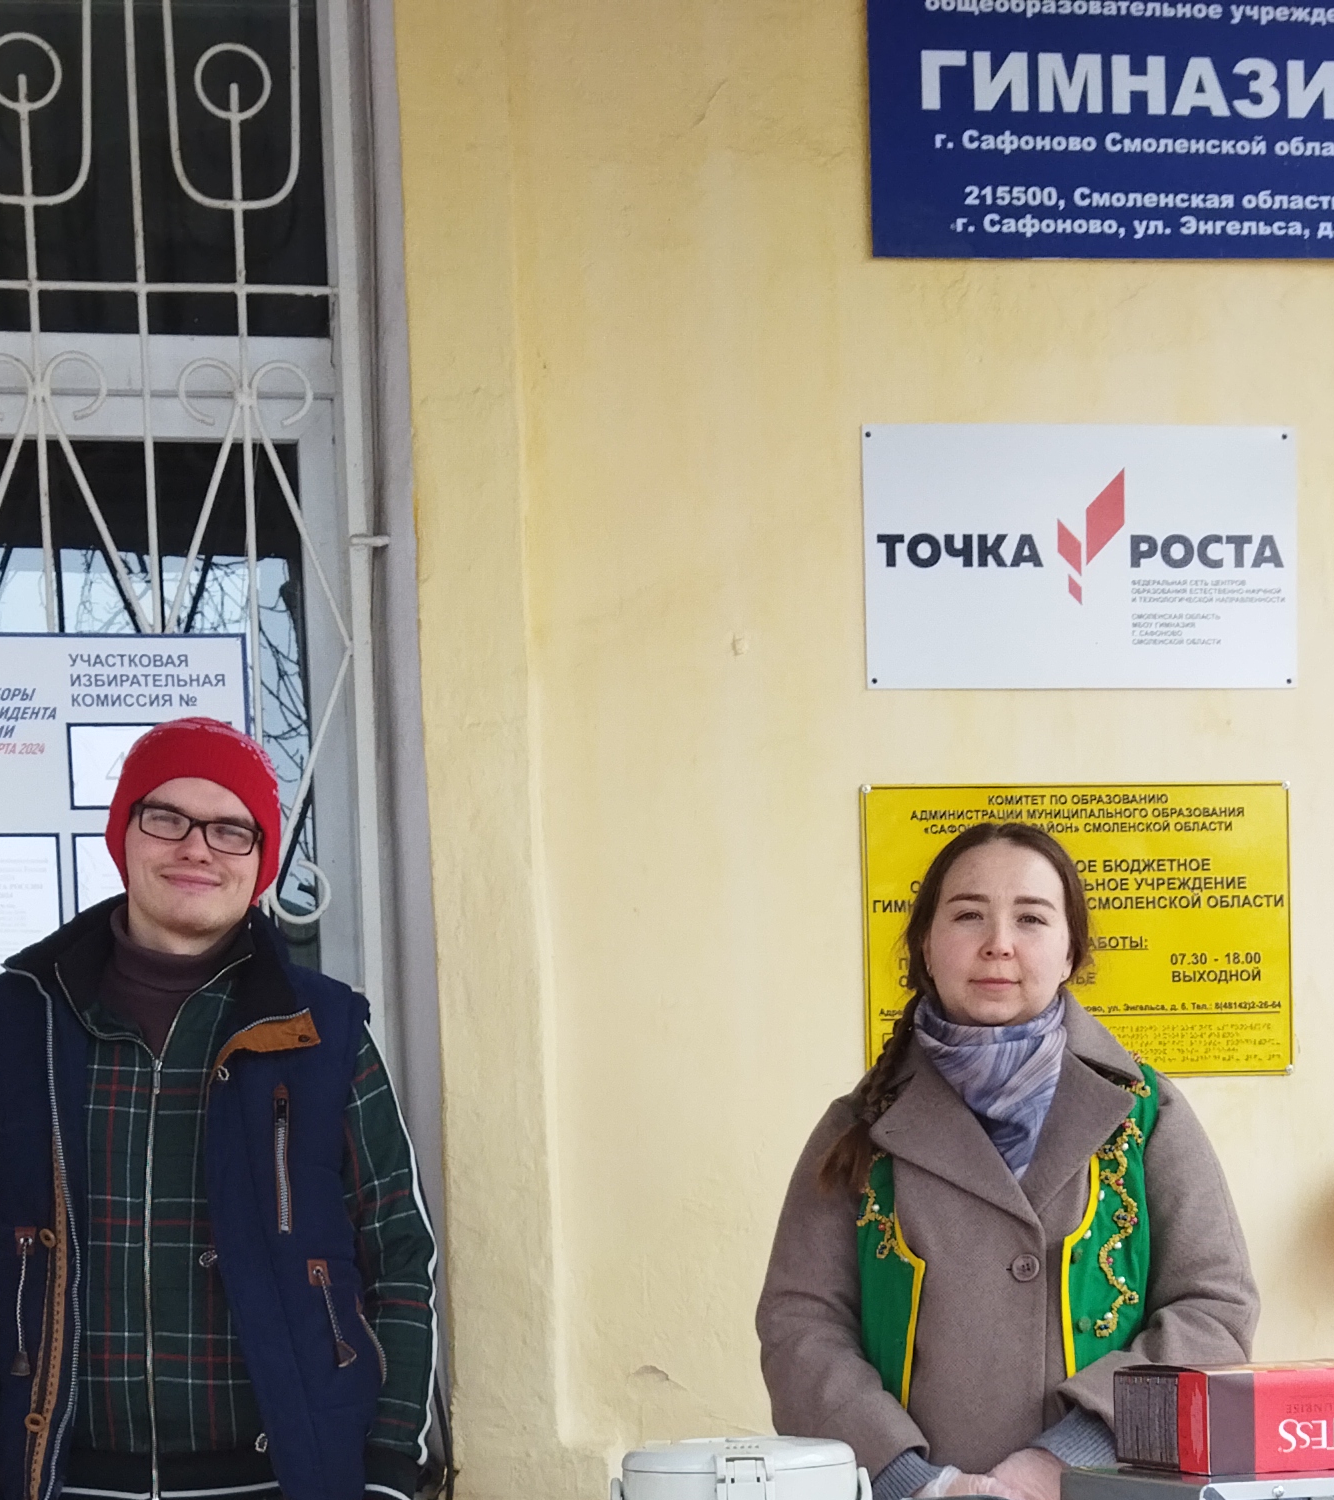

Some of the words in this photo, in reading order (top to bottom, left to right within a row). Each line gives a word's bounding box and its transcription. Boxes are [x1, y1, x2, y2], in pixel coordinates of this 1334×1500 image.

[935, 133, 953, 150] г.
[962, 130, 1097, 154] Сафоново
[1105, 132, 1267, 156] Смоленской
[964, 186, 1065, 210] 215500,
[1073, 186, 1235, 210] Смоленская
[955, 217, 975, 232] г.
[983, 214, 1125, 238] Сафоново,
[1133, 218, 1172, 238] ул.
[1179, 216, 1310, 240] Энгельса,
[876, 533, 1043, 568] ТОЧКА
[1130, 534, 1284, 568] РОСТА
[68, 654, 188, 667] УЧАСТКОВАЯ
[70, 674, 226, 687] ИЗБИРАТЕЛЬНАЯ
[71, 694, 172, 707] КОМИССИЯ
[179, 694, 197, 707] №
[18, 743, 46, 755] 2024
[988, 794, 1046, 806] КОМИТЕТ
[1049, 794, 1068, 805] ПО
[1071, 794, 1169, 805] ОБРАЗОВАНИЮ
[910, 808, 1023, 823] АДМИНИСТРАЦИИ
[1027, 807, 1149, 821] МУНИЦИПАЛЬНОГО
[1151, 806, 1245, 818] ОБРАЗОВАНИЯ
[1084, 820, 1170, 833] СМОЛЕНСКОЙ
[1174, 821, 1233, 832] ОБЛАСТИ
[1103, 857, 1211, 875] БЮДЖЕТНОЕ
[1134, 876, 1247, 892] УЧРЕЖДЕНИЕ
[1087, 892, 1202, 911] СМОЛЕНСКОЙ
[1207, 893, 1285, 909] ОБЛАСТИ
[1170, 952, 1207, 965] 07.30
[1225, 952, 1261, 965] 18.00
[1171, 967, 1262, 985] ВЫХОДНОЙ
